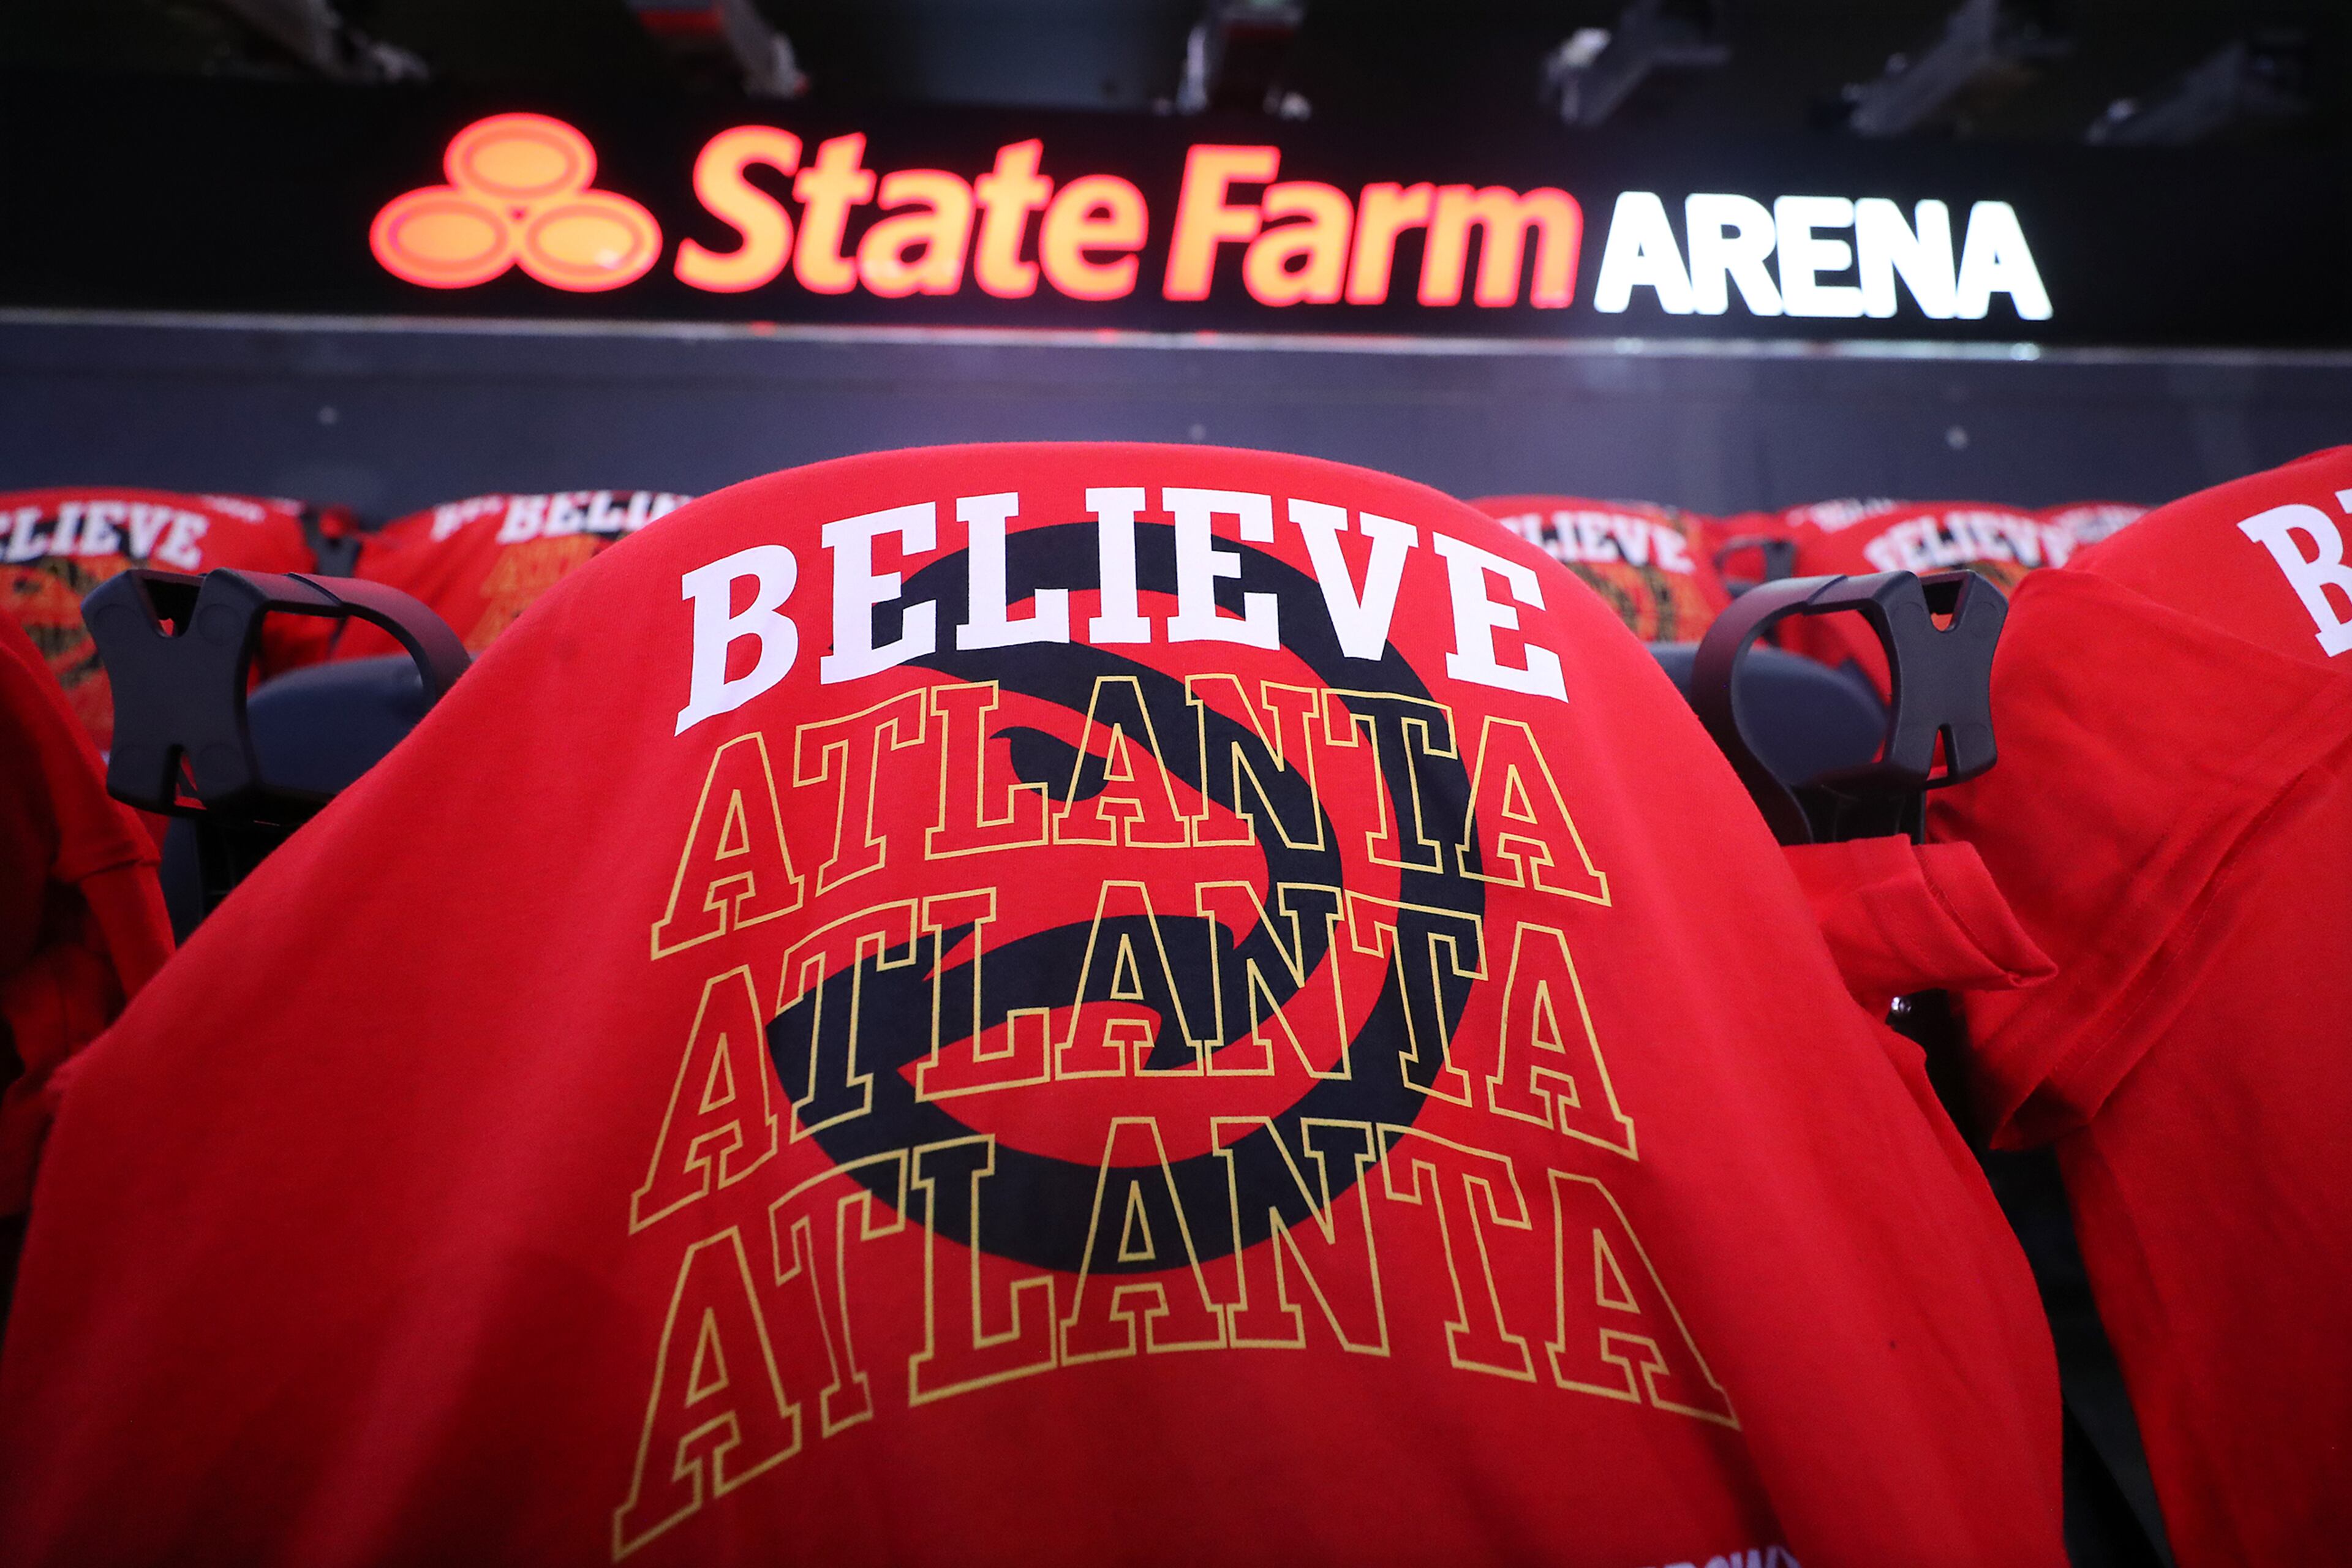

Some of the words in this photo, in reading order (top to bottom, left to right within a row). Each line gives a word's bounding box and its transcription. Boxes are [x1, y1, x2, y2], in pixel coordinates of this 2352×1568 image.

[674, 125, 1149, 300] State
[1161, 144, 1584, 308] Farm
[1593, 191, 2053, 320] ARENA
[0, 499, 209, 570] LIEVE
[675, 487, 1568, 736] BELIEVE
[1499, 510, 1697, 575] LIEVE
[651, 672, 1611, 961] ATLANTA
[629, 880, 1638, 1233] ATLANTA
[612, 1115, 1741, 1561] ATLANTA
